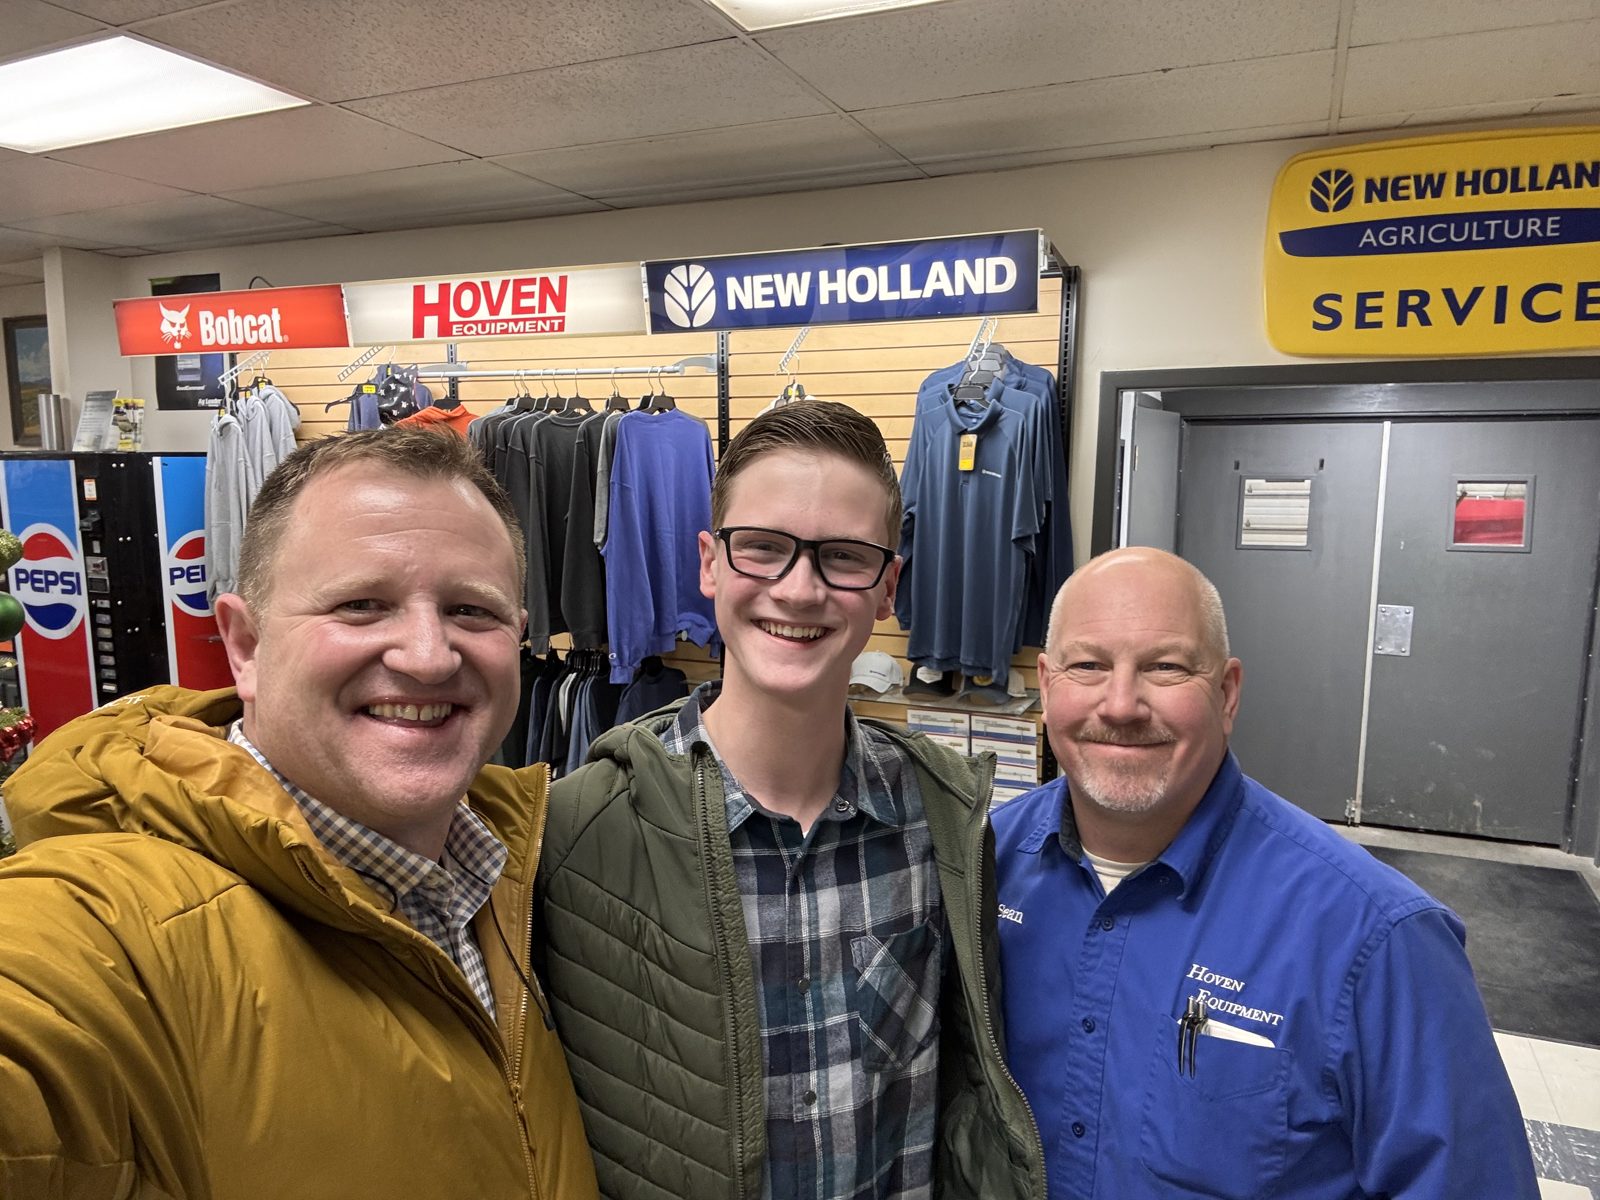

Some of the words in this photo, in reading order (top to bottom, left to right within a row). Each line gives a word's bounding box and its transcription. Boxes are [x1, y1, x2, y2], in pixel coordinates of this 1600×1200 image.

[1364, 171, 1447, 204] NEW
[1455, 161, 1600, 197] HOLLAN
[1358, 216, 1562, 249] AGRICULTURE
[726, 271, 812, 310] NEW
[818, 256, 1018, 305] HOLLAND
[412, 274, 568, 339] HOVEN
[1311, 281, 1600, 332] SERVICE
[199, 307, 283, 346] Bobcat
[451, 319, 564, 336] EQUIPMENT
[14, 568, 82, 596] PEPSI
[997, 903, 1024, 925] Sean
[1186, 963, 1246, 993] HOVEN
[1195, 988, 1284, 1026] EQUIPMENT
